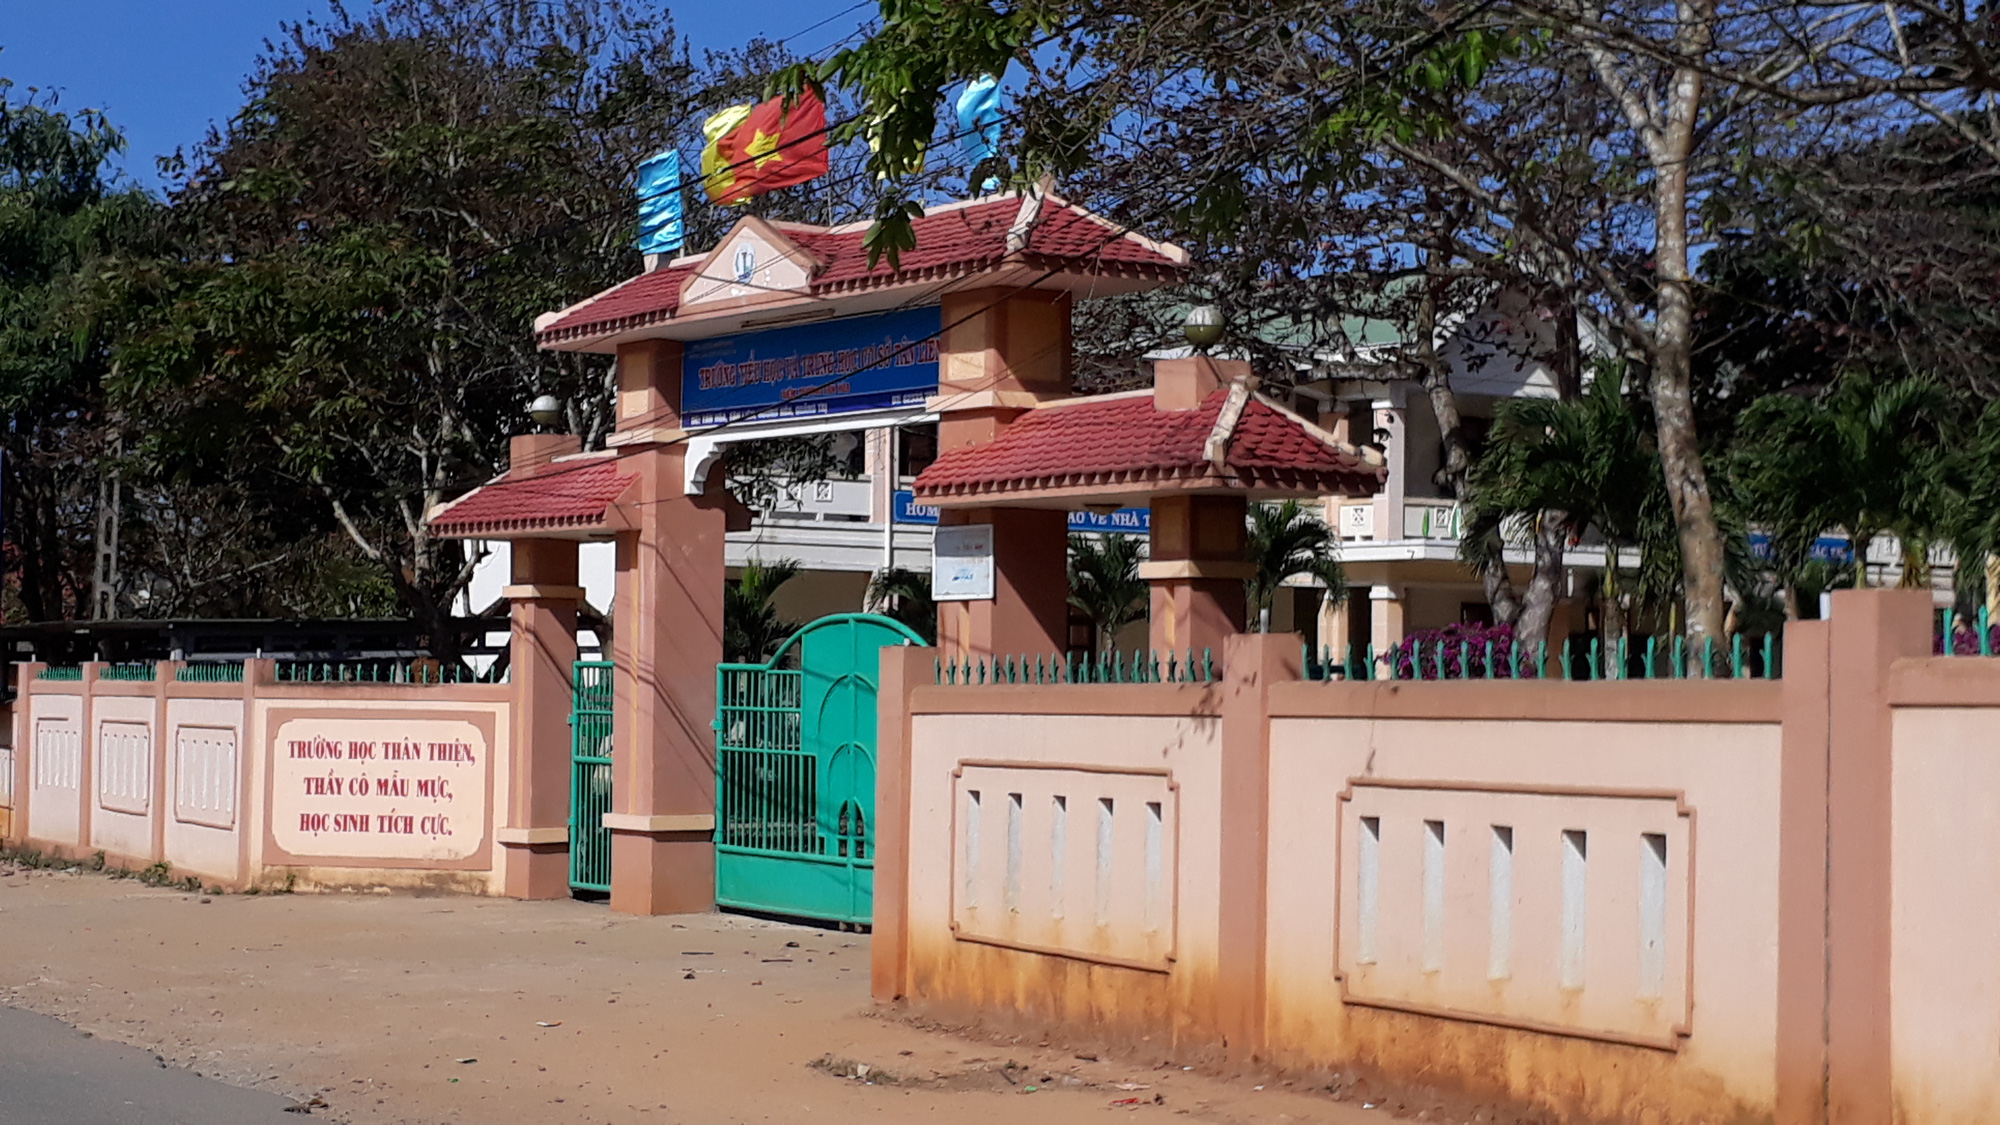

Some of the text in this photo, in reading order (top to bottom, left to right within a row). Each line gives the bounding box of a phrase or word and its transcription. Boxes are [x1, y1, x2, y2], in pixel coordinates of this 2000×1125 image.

[1111, 511, 1140, 527] NHÀ
[288, 734, 476, 767] TRƯỜNG HỌC THÂN THIỆN,
[303, 768, 453, 804] THẦY CÔ MẪU MỰC,
[299, 808, 453, 841] HỌC SINH TÍCH CỰC.
